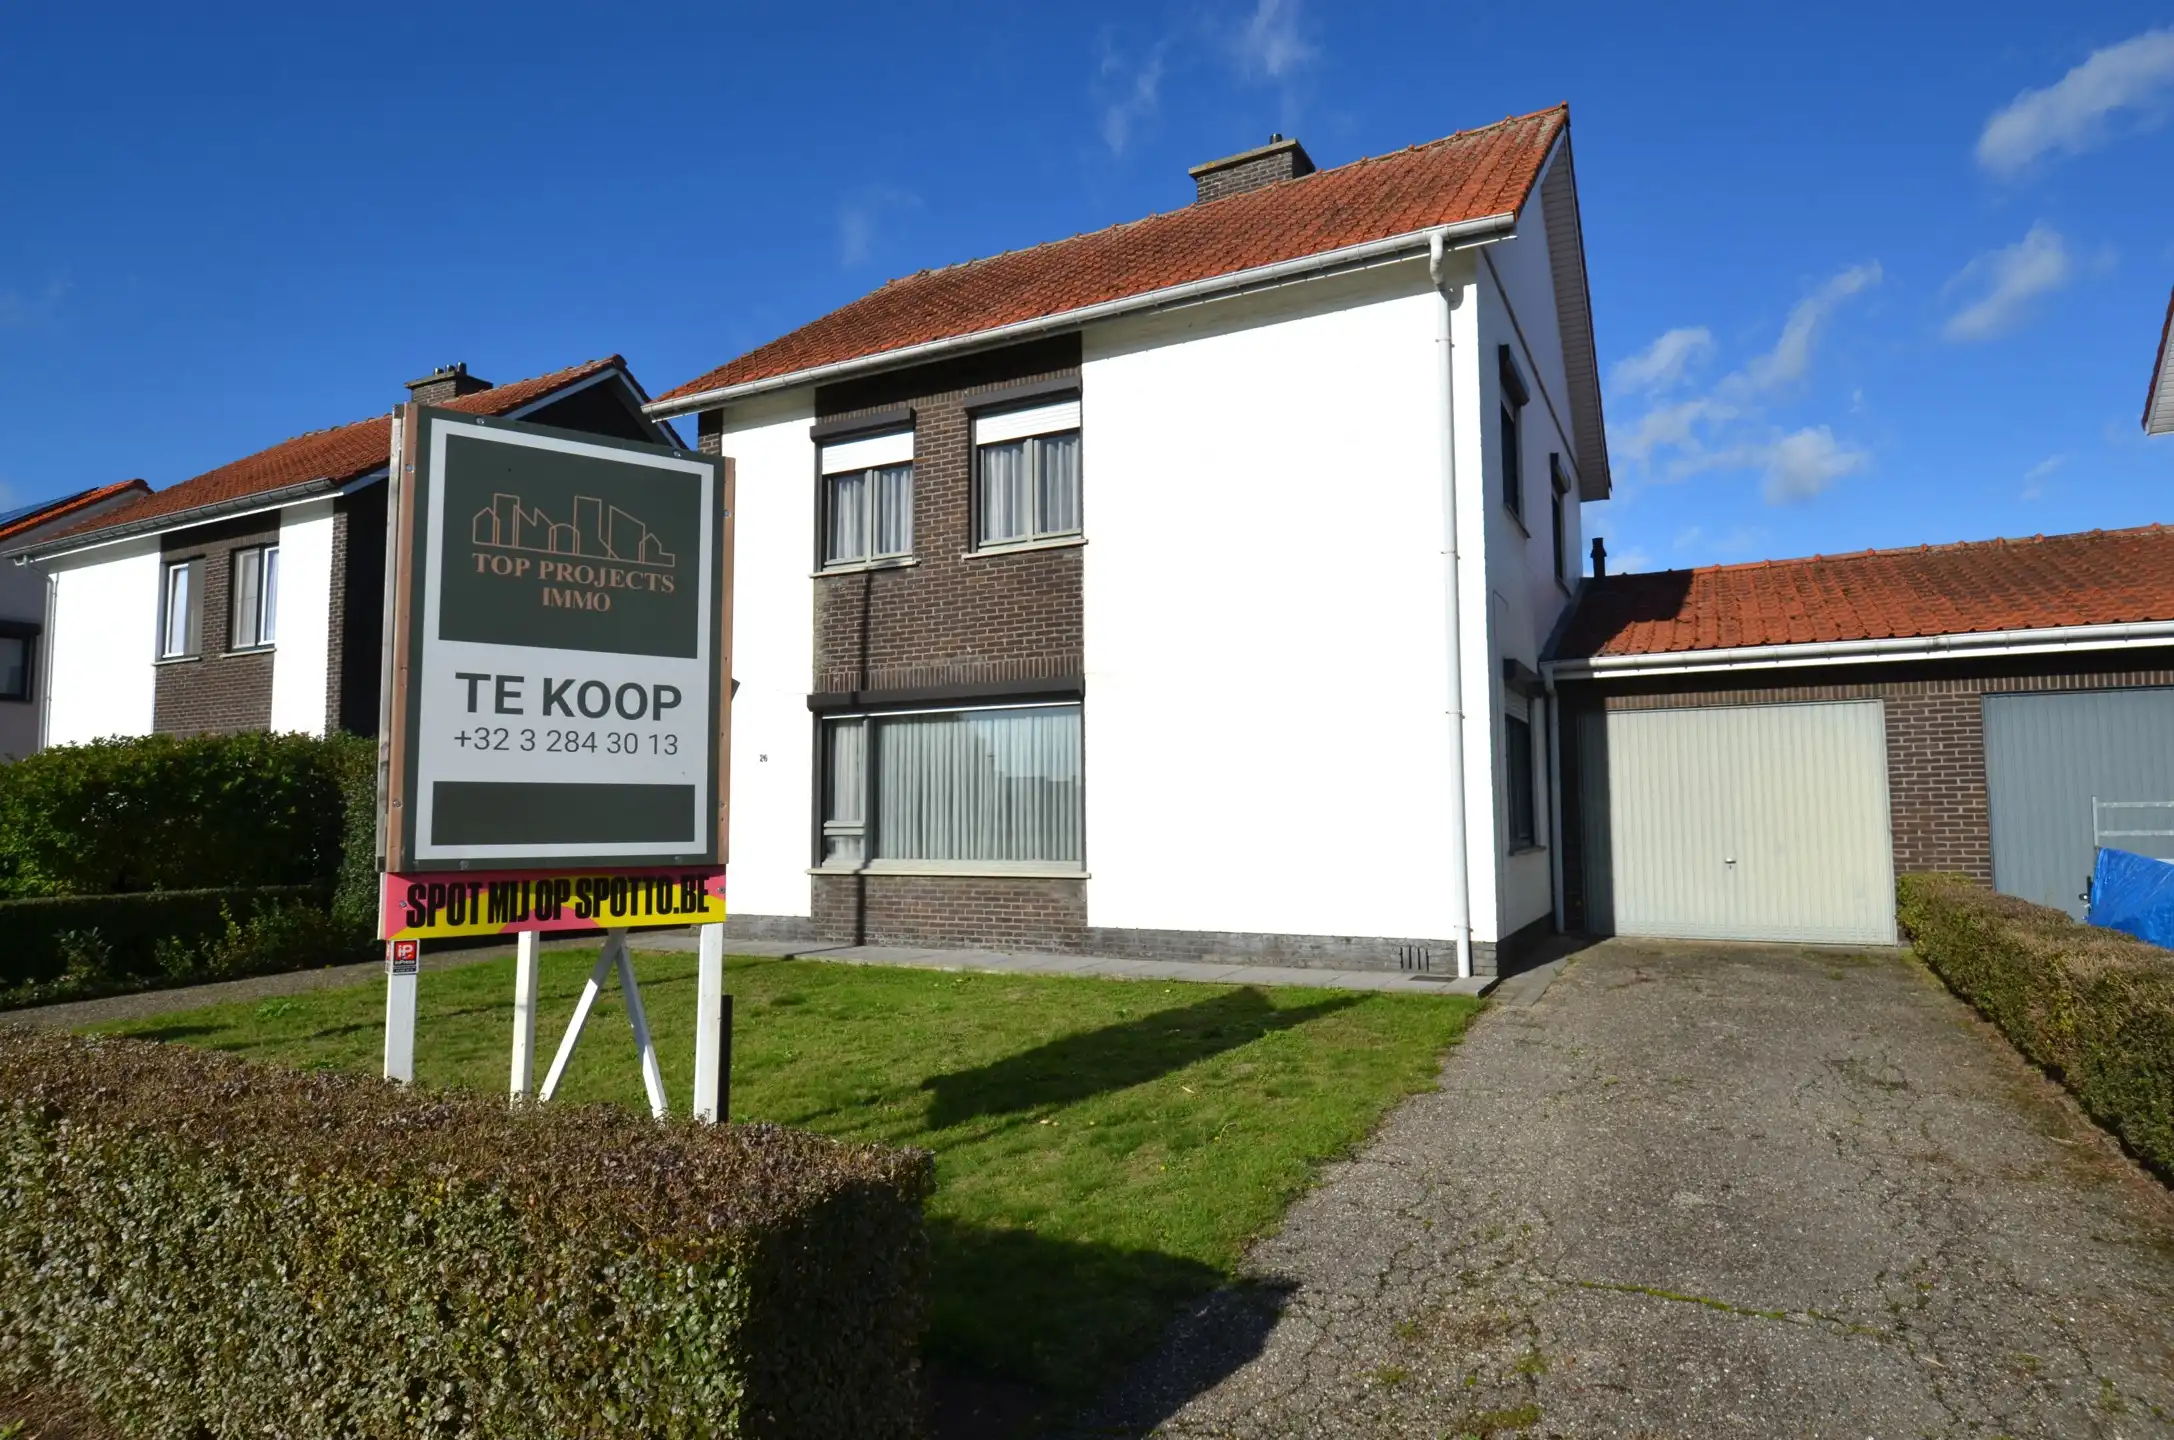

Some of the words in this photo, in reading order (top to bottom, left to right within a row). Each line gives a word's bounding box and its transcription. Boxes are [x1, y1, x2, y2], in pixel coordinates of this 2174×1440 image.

[471, 552, 530, 577] TOP
[538, 560, 675, 593] PROJECTS
[542, 587, 611, 612] IMMO
[455, 672, 524, 715] TE
[542, 677, 682, 721] KOOP
[454, 727, 510, 751] +32
[519, 728, 536, 752] 3
[546, 729, 598, 754] 284
[606, 732, 638, 754] 30
[648, 733, 679, 756] 13
[406, 881, 483, 928] SPOT
[487, 880, 530, 924] MIJ
[534, 878, 571, 922] OP
[575, 875, 709, 919] SPOTTO.BE
